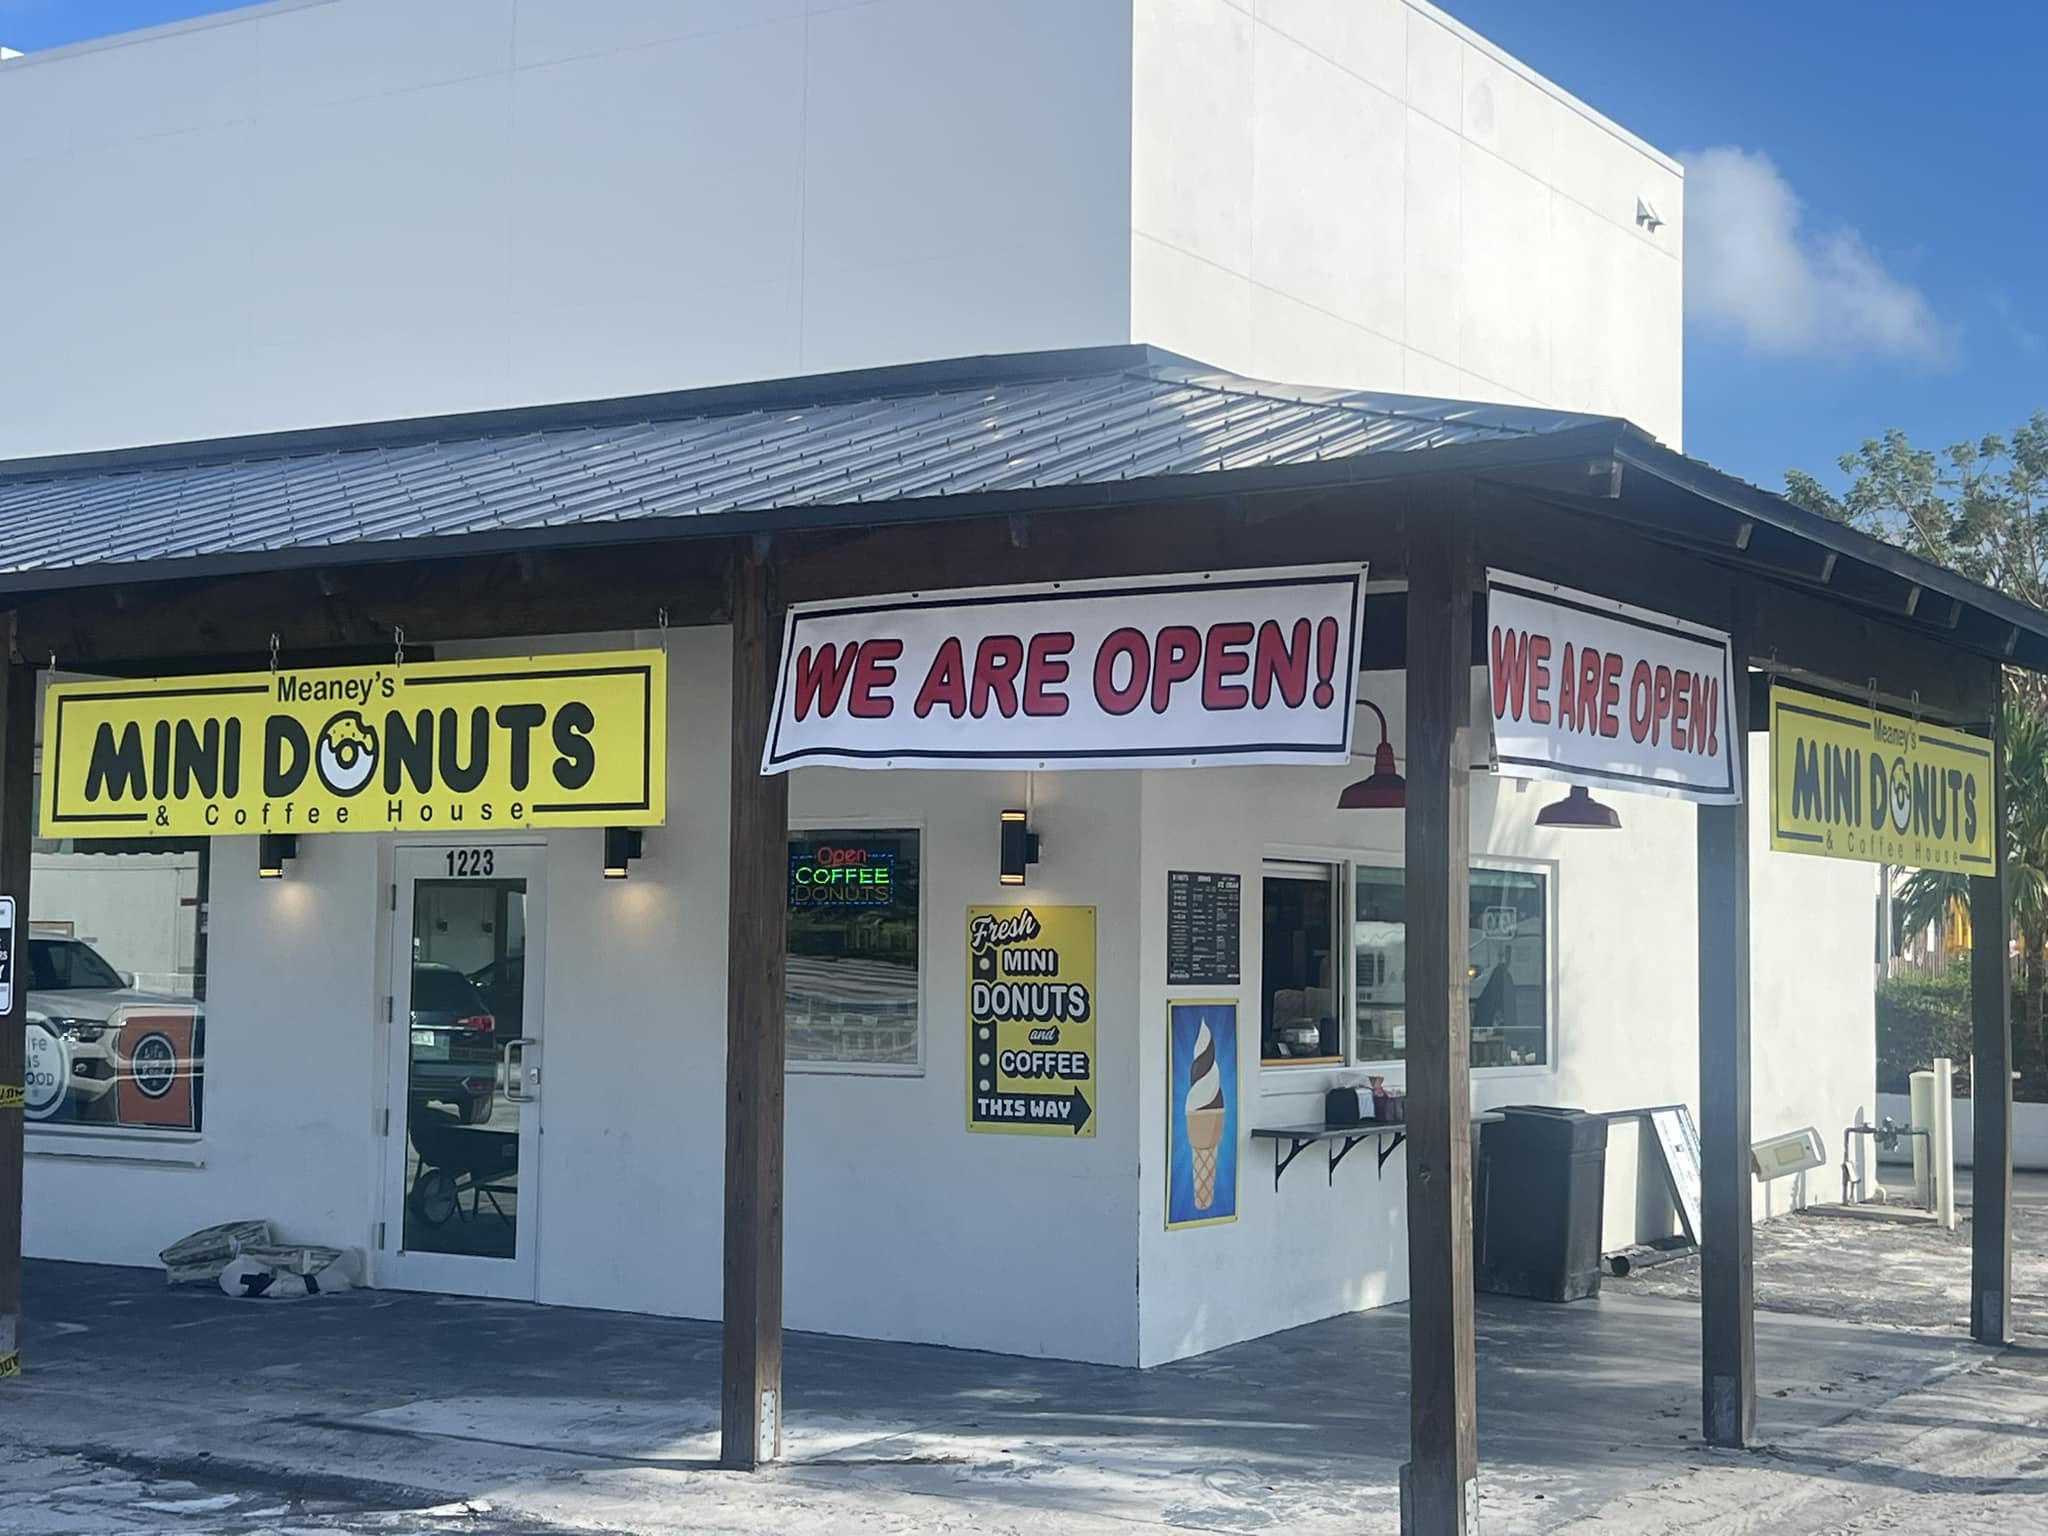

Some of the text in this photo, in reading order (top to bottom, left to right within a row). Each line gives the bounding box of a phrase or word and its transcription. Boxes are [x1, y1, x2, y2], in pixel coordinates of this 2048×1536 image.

[794, 616, 1339, 723] WE ARE OPEN!
[277, 671, 395, 705] Meaney's
[1491, 625, 1718, 757] WE ARE OPEN!
[1873, 717, 1917, 753] Meaney's
[85, 701, 595, 801] MINI DONUTS
[1792, 737, 1977, 844] MINI DONUTS
[155, 800, 523, 826] & Coffee House
[817, 846, 867, 867] Open
[1826, 829, 1959, 865] & Coffee House
[446, 849, 494, 877] 1223
[795, 867, 889, 884] COFFEE
[795, 885, 889, 901] DONUTS
[970, 909, 1039, 948] Fresh
[1003, 950, 1056, 973] MINI
[972, 983, 1087, 1019] DONUTS
[1029, 1026, 1057, 1042] and
[1001, 1051, 1086, 1074] COFFEE
[978, 1098, 1072, 1119] THIS WAY
